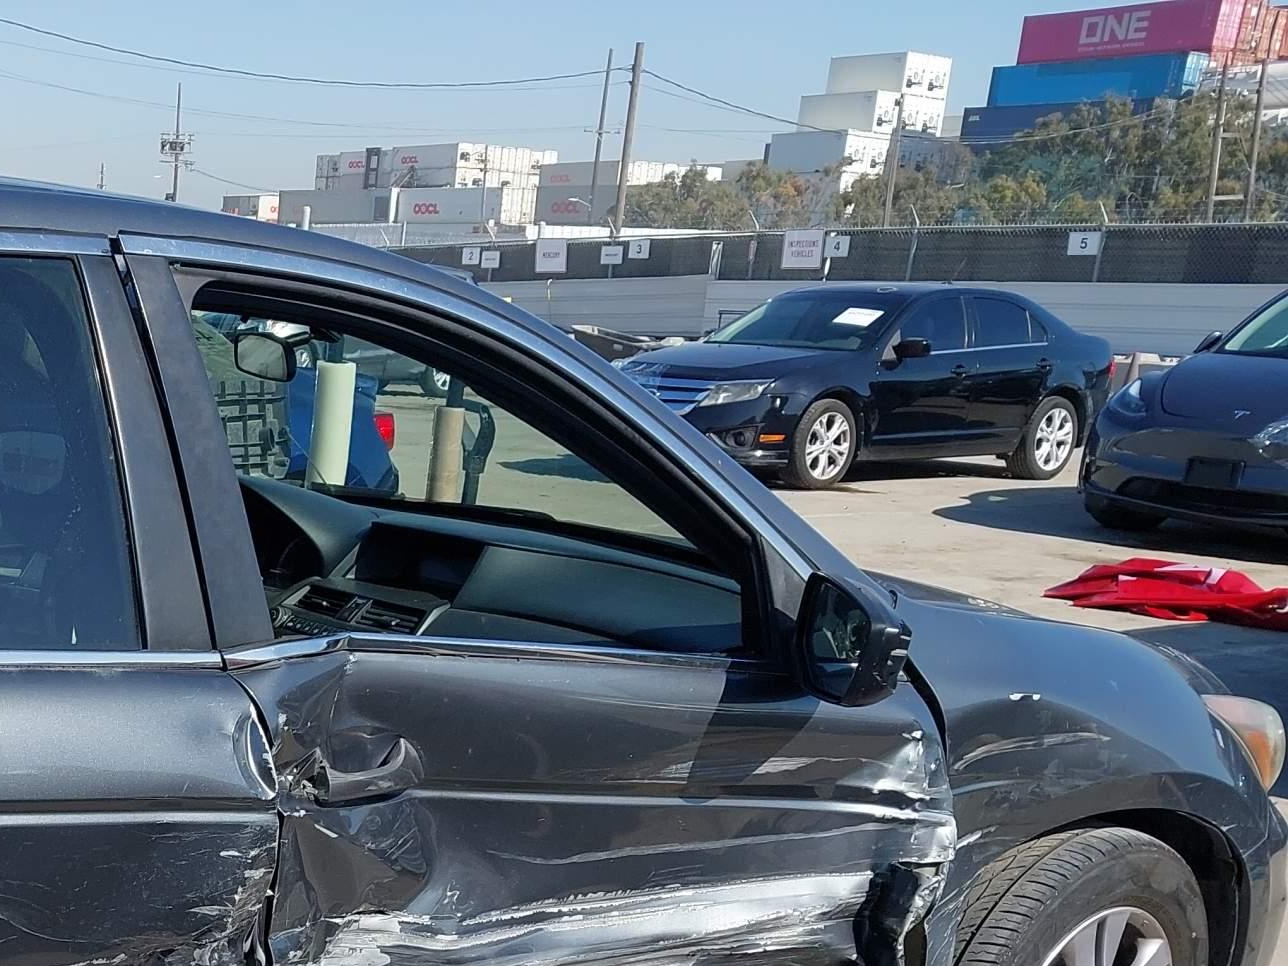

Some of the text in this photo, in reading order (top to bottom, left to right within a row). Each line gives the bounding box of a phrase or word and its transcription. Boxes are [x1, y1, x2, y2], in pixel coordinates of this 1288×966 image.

[1079, 10, 1151, 44] ONE
[413, 203, 440, 215] OOCL
[834, 241, 840, 251] 4
[1080, 237, 1089, 249] 5
[636, 244, 642, 254] 3
[468, 251, 474, 260] 2
